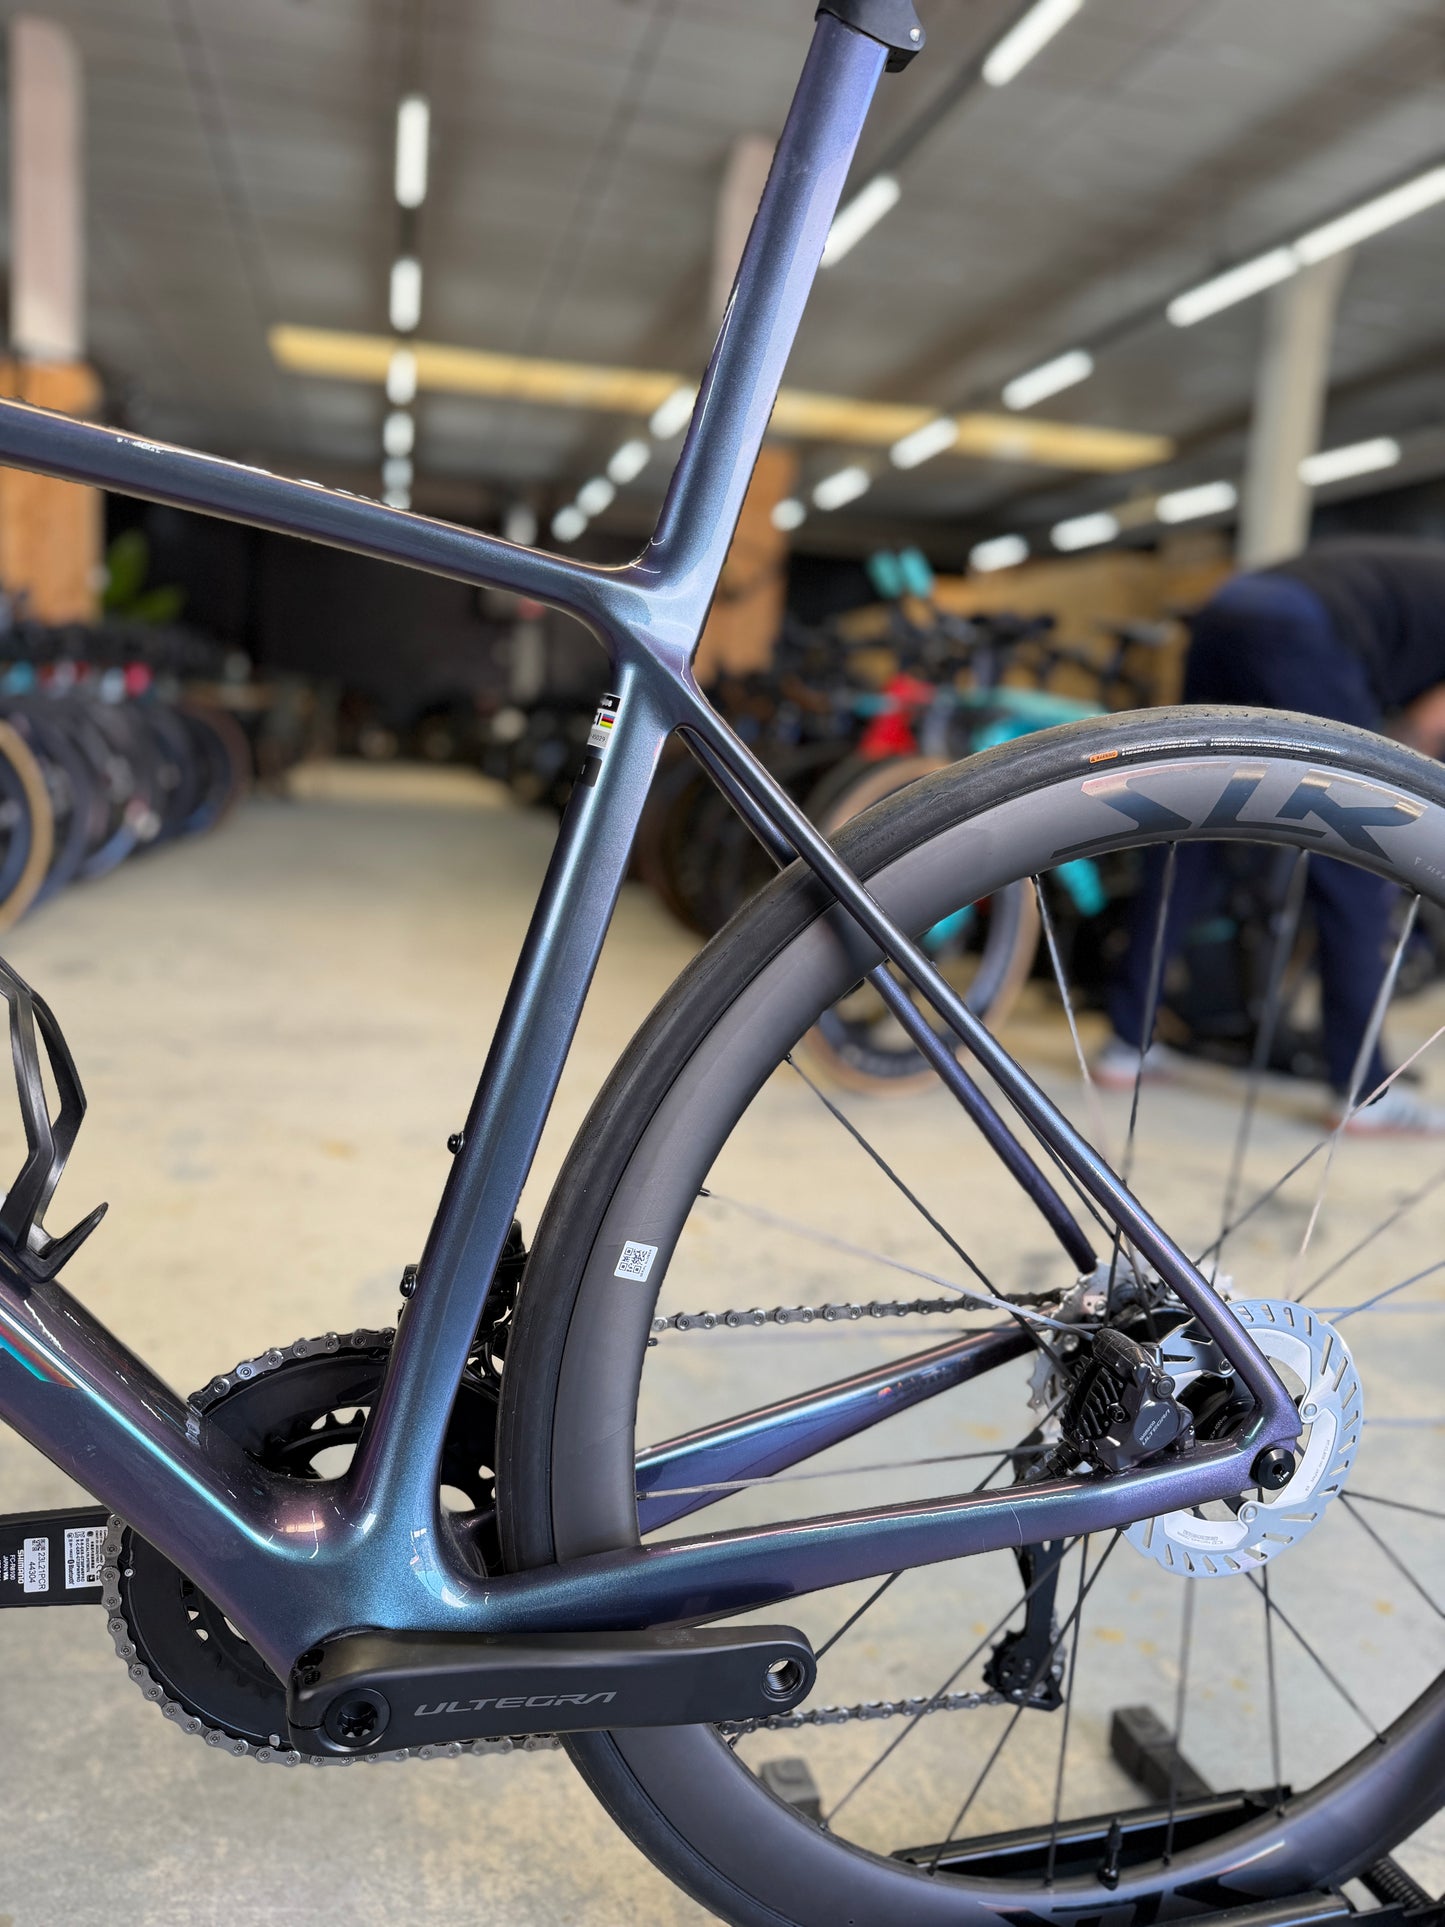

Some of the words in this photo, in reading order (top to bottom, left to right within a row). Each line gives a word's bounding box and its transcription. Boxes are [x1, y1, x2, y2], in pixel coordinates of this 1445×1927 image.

[1051, 762, 1429, 864] SLR
[1142, 1408, 1171, 1446] ULTEGRA
[413, 1691, 618, 1717] ULTEGRA
